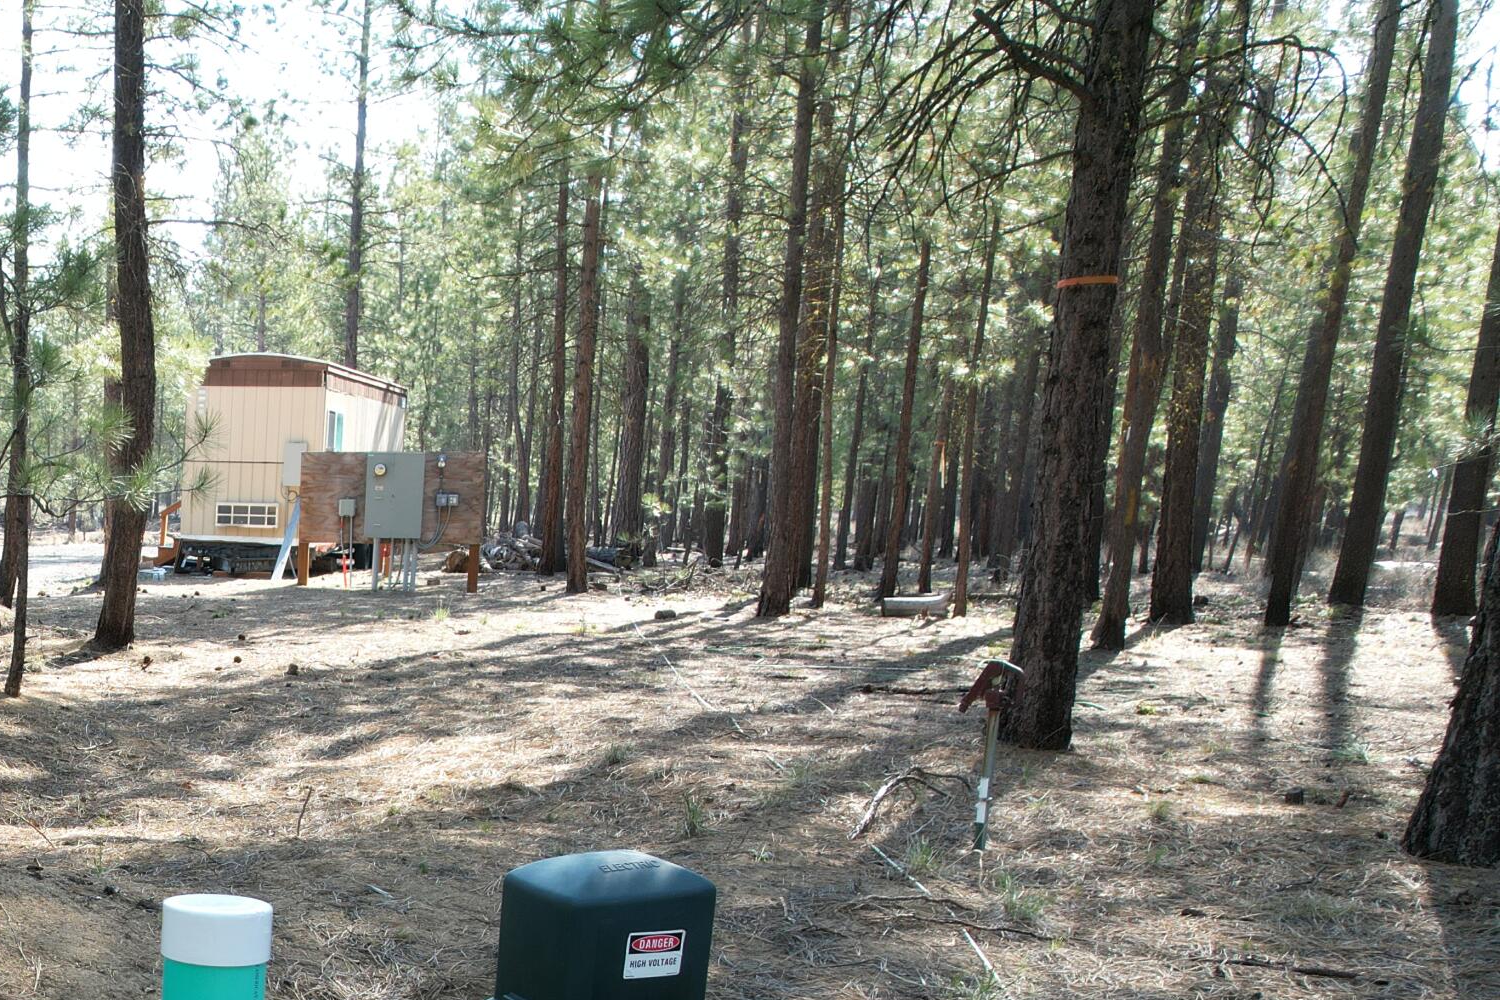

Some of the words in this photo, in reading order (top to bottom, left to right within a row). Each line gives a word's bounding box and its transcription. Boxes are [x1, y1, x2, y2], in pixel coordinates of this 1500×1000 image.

[598, 860, 661, 873] ELECTRIC
[639, 937, 674, 949] DANGER
[629, 959, 646, 968] HIGH
[648, 957, 677, 967] VOLTAGE
